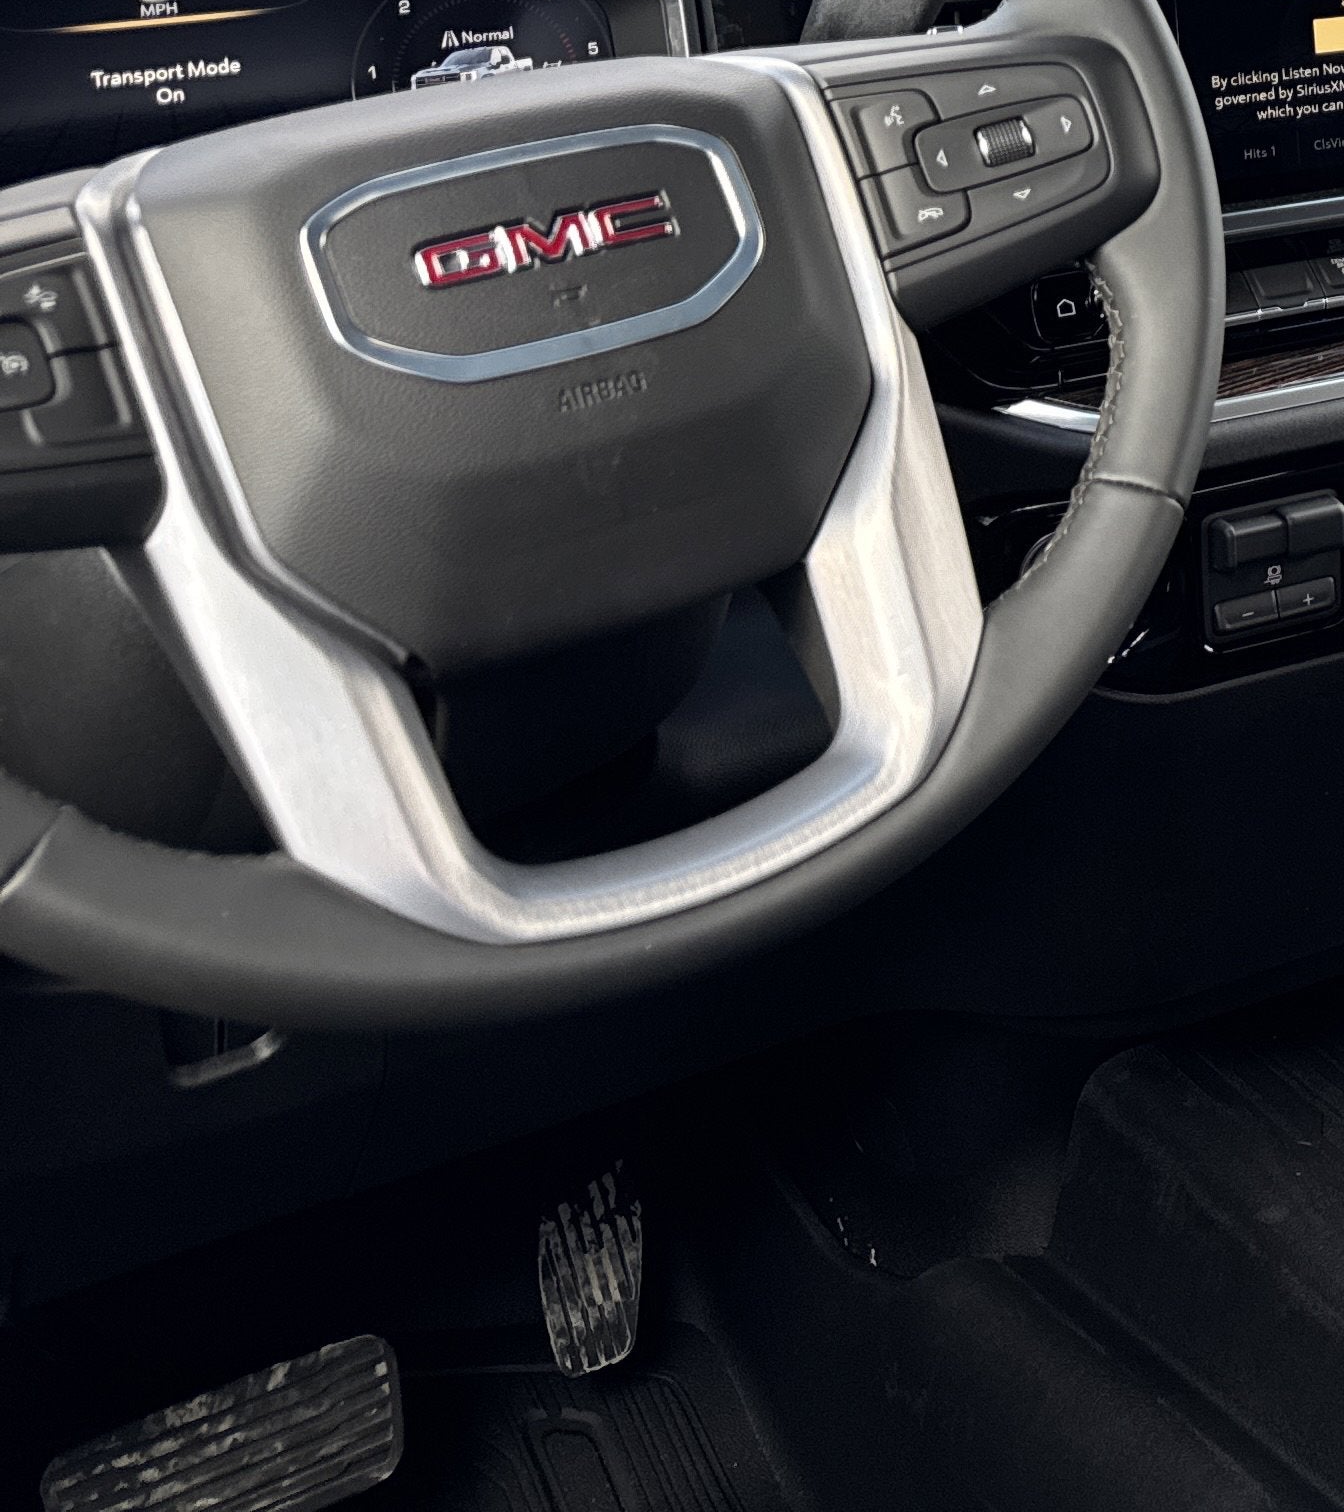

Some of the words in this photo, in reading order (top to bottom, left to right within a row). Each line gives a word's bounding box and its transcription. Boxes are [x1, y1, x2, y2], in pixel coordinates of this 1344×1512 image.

[140, 1, 178, 18] MPH
[398, 0, 411, 16] 2
[461, 25, 514, 44] Normal
[587, 41, 599, 56] 5
[90, 61, 184, 89] Transport
[187, 57, 241, 79] Mode
[367, 65, 377, 81] 1
[1211, 75, 1228, 91] By
[1231, 70, 1279, 86] clicking
[1282, 66, 1320, 80] Listen
[156, 87, 185, 105] On
[1215, 88, 1276, 110] governed
[1279, 85, 1294, 102] by
[1256, 104, 1294, 120] which
[1295, 103, 1319, 119] you
[1322, 100, 1344, 112] can
[1244, 148, 1267, 160] Hits
[412, 190, 681, 286] GMC
[558, 370, 647, 414] AIRBAG
